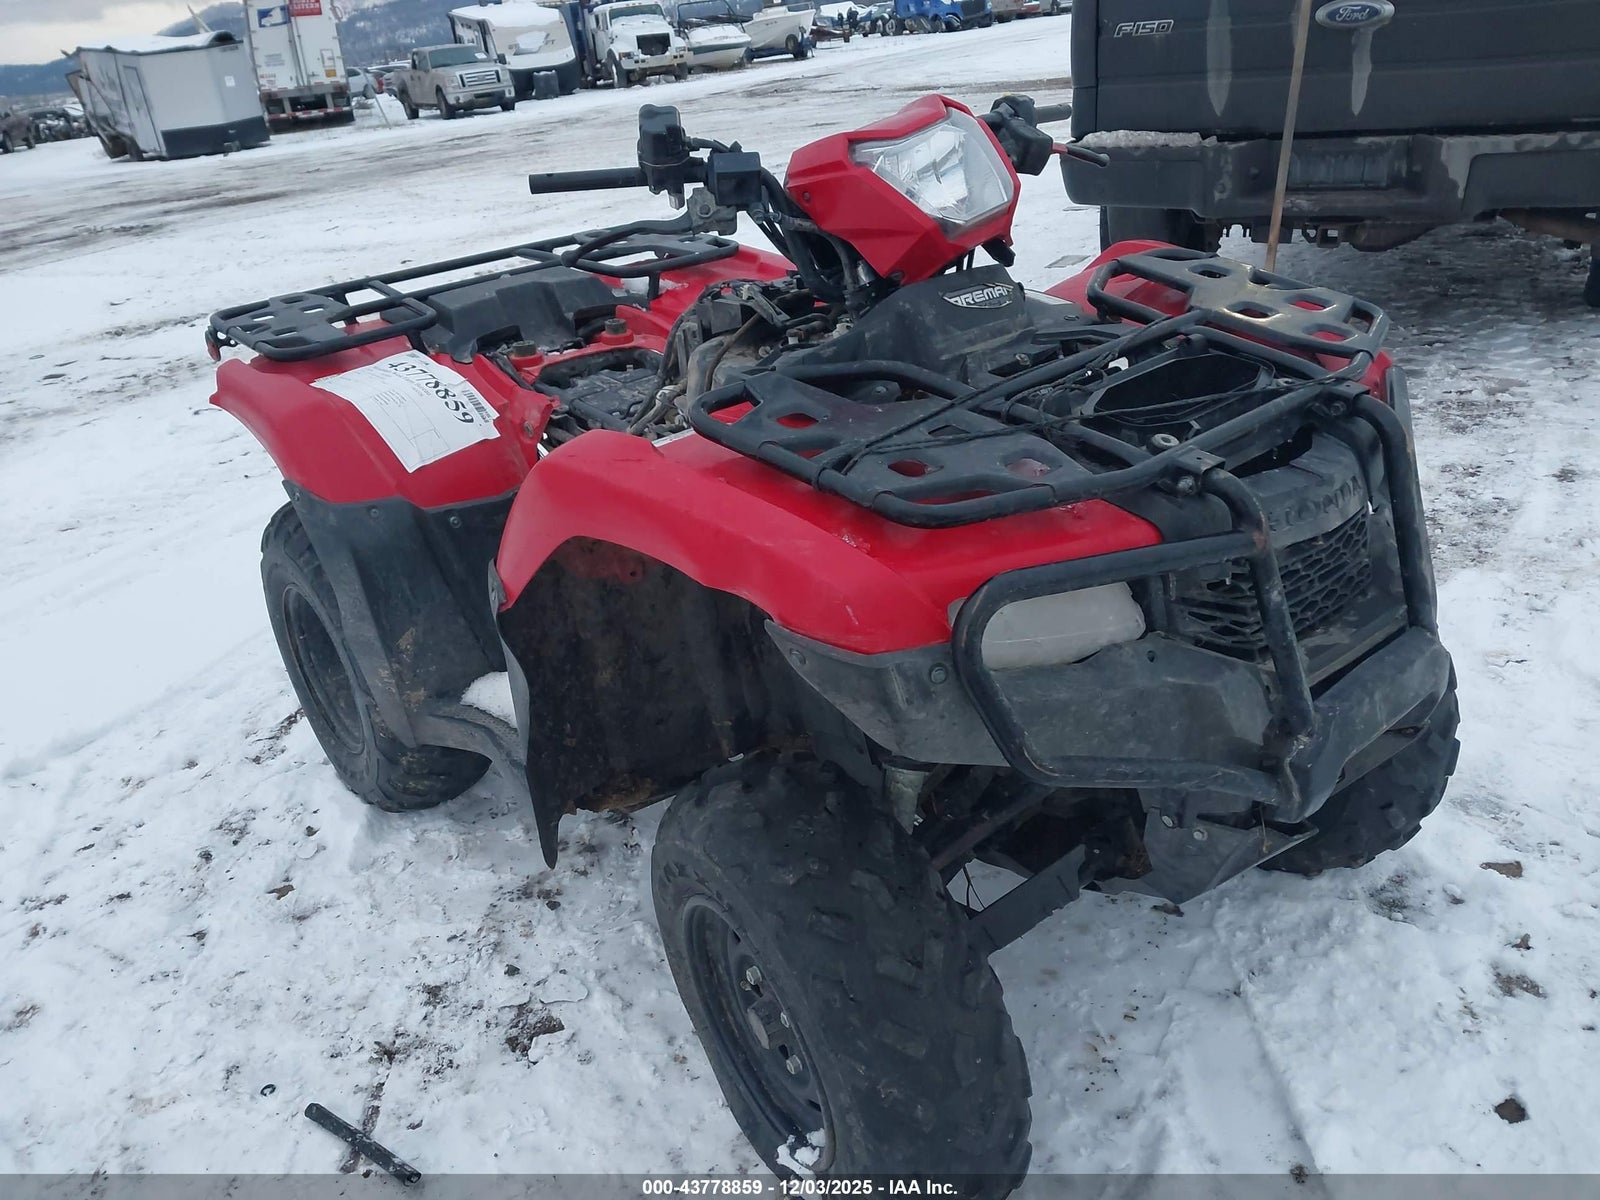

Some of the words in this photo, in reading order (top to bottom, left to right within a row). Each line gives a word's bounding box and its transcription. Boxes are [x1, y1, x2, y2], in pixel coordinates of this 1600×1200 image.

[1336, 6, 1370, 21] Ford
[1114, 19, 1174, 38] F-150
[388, 361, 475, 424] 43778859
